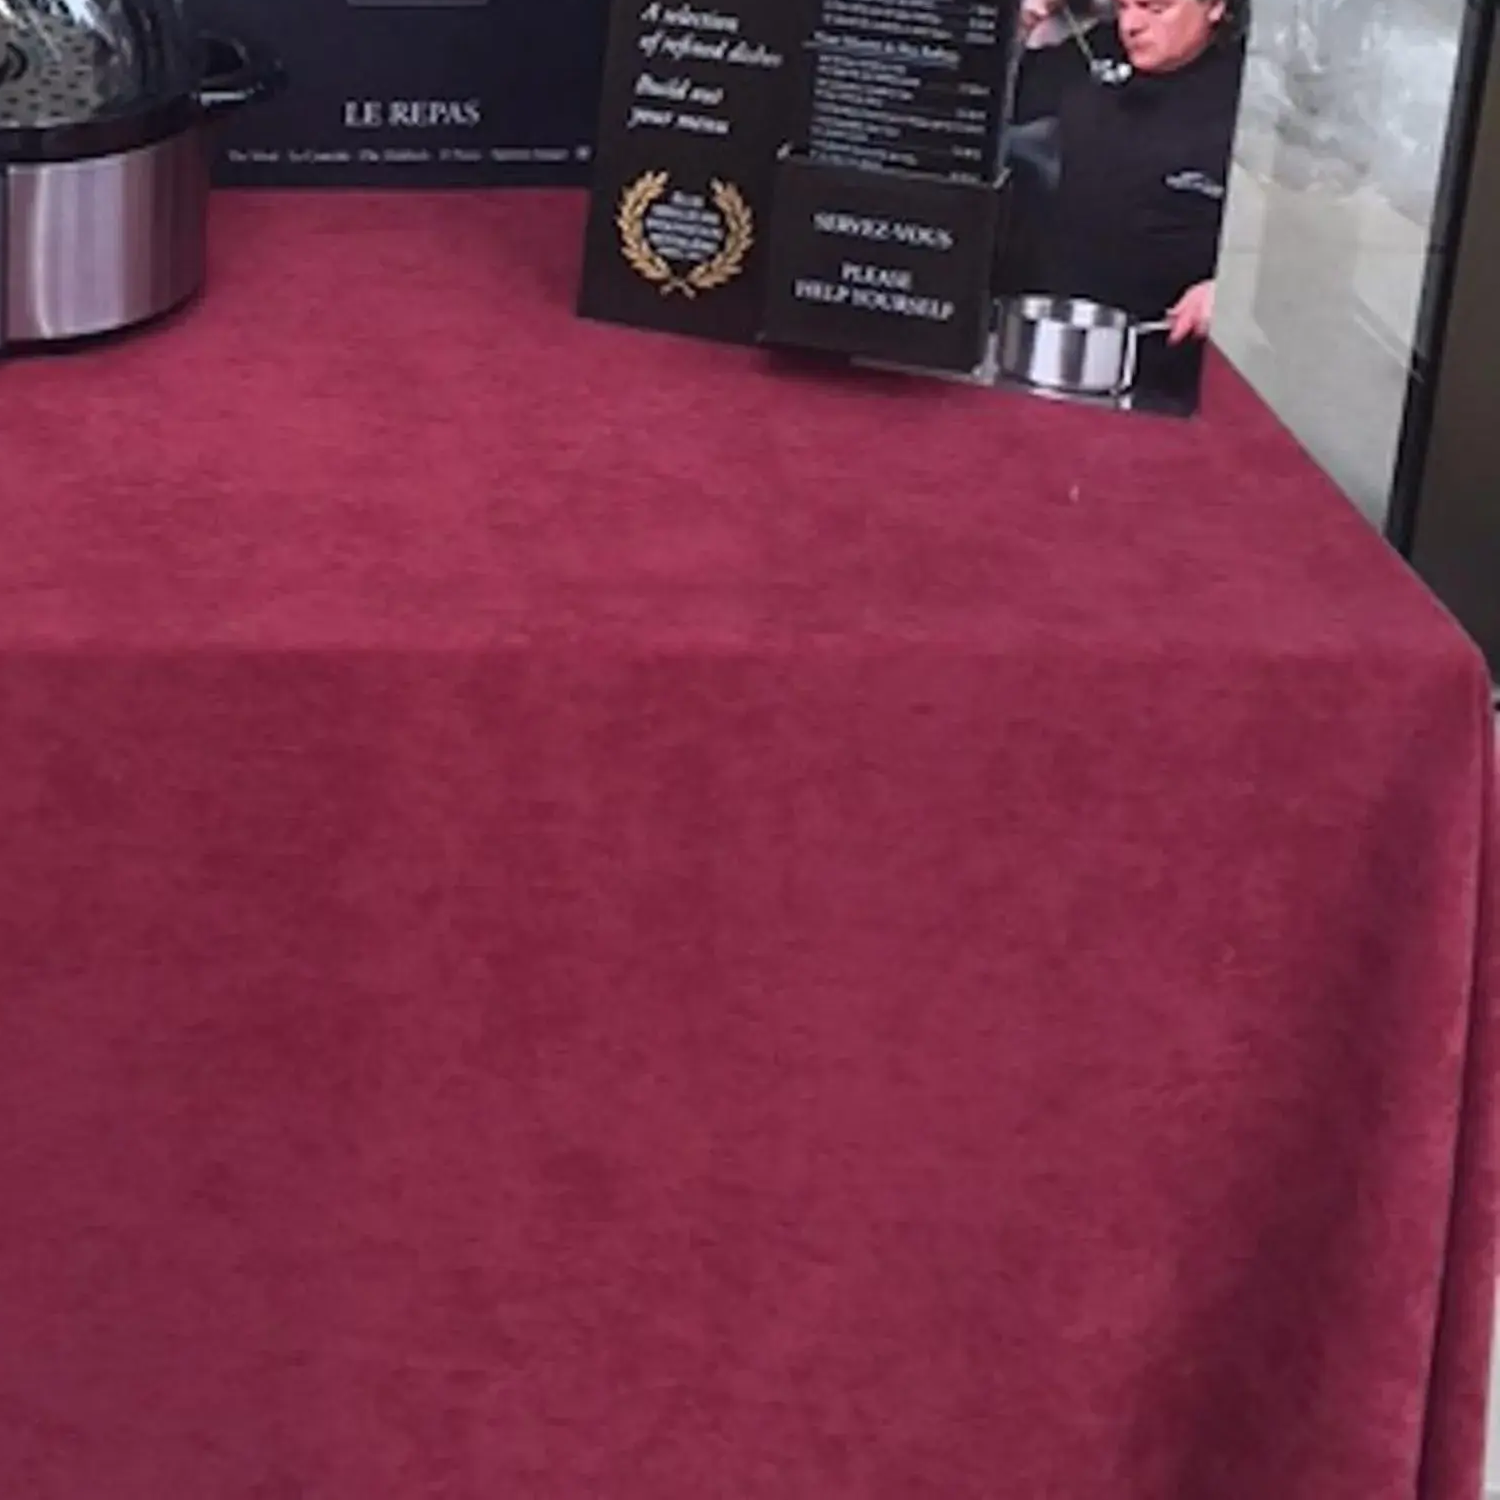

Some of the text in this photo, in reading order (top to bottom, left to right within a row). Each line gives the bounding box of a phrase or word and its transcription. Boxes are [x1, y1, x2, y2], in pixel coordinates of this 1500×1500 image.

[344, 101, 482, 128] LE REPAS
[677, 114, 730, 135] menu
[813, 212, 954, 250] SERVEZ-VOUS
[841, 261, 914, 291] PLEASE
[794, 278, 955, 321] HELP YOURSELF
